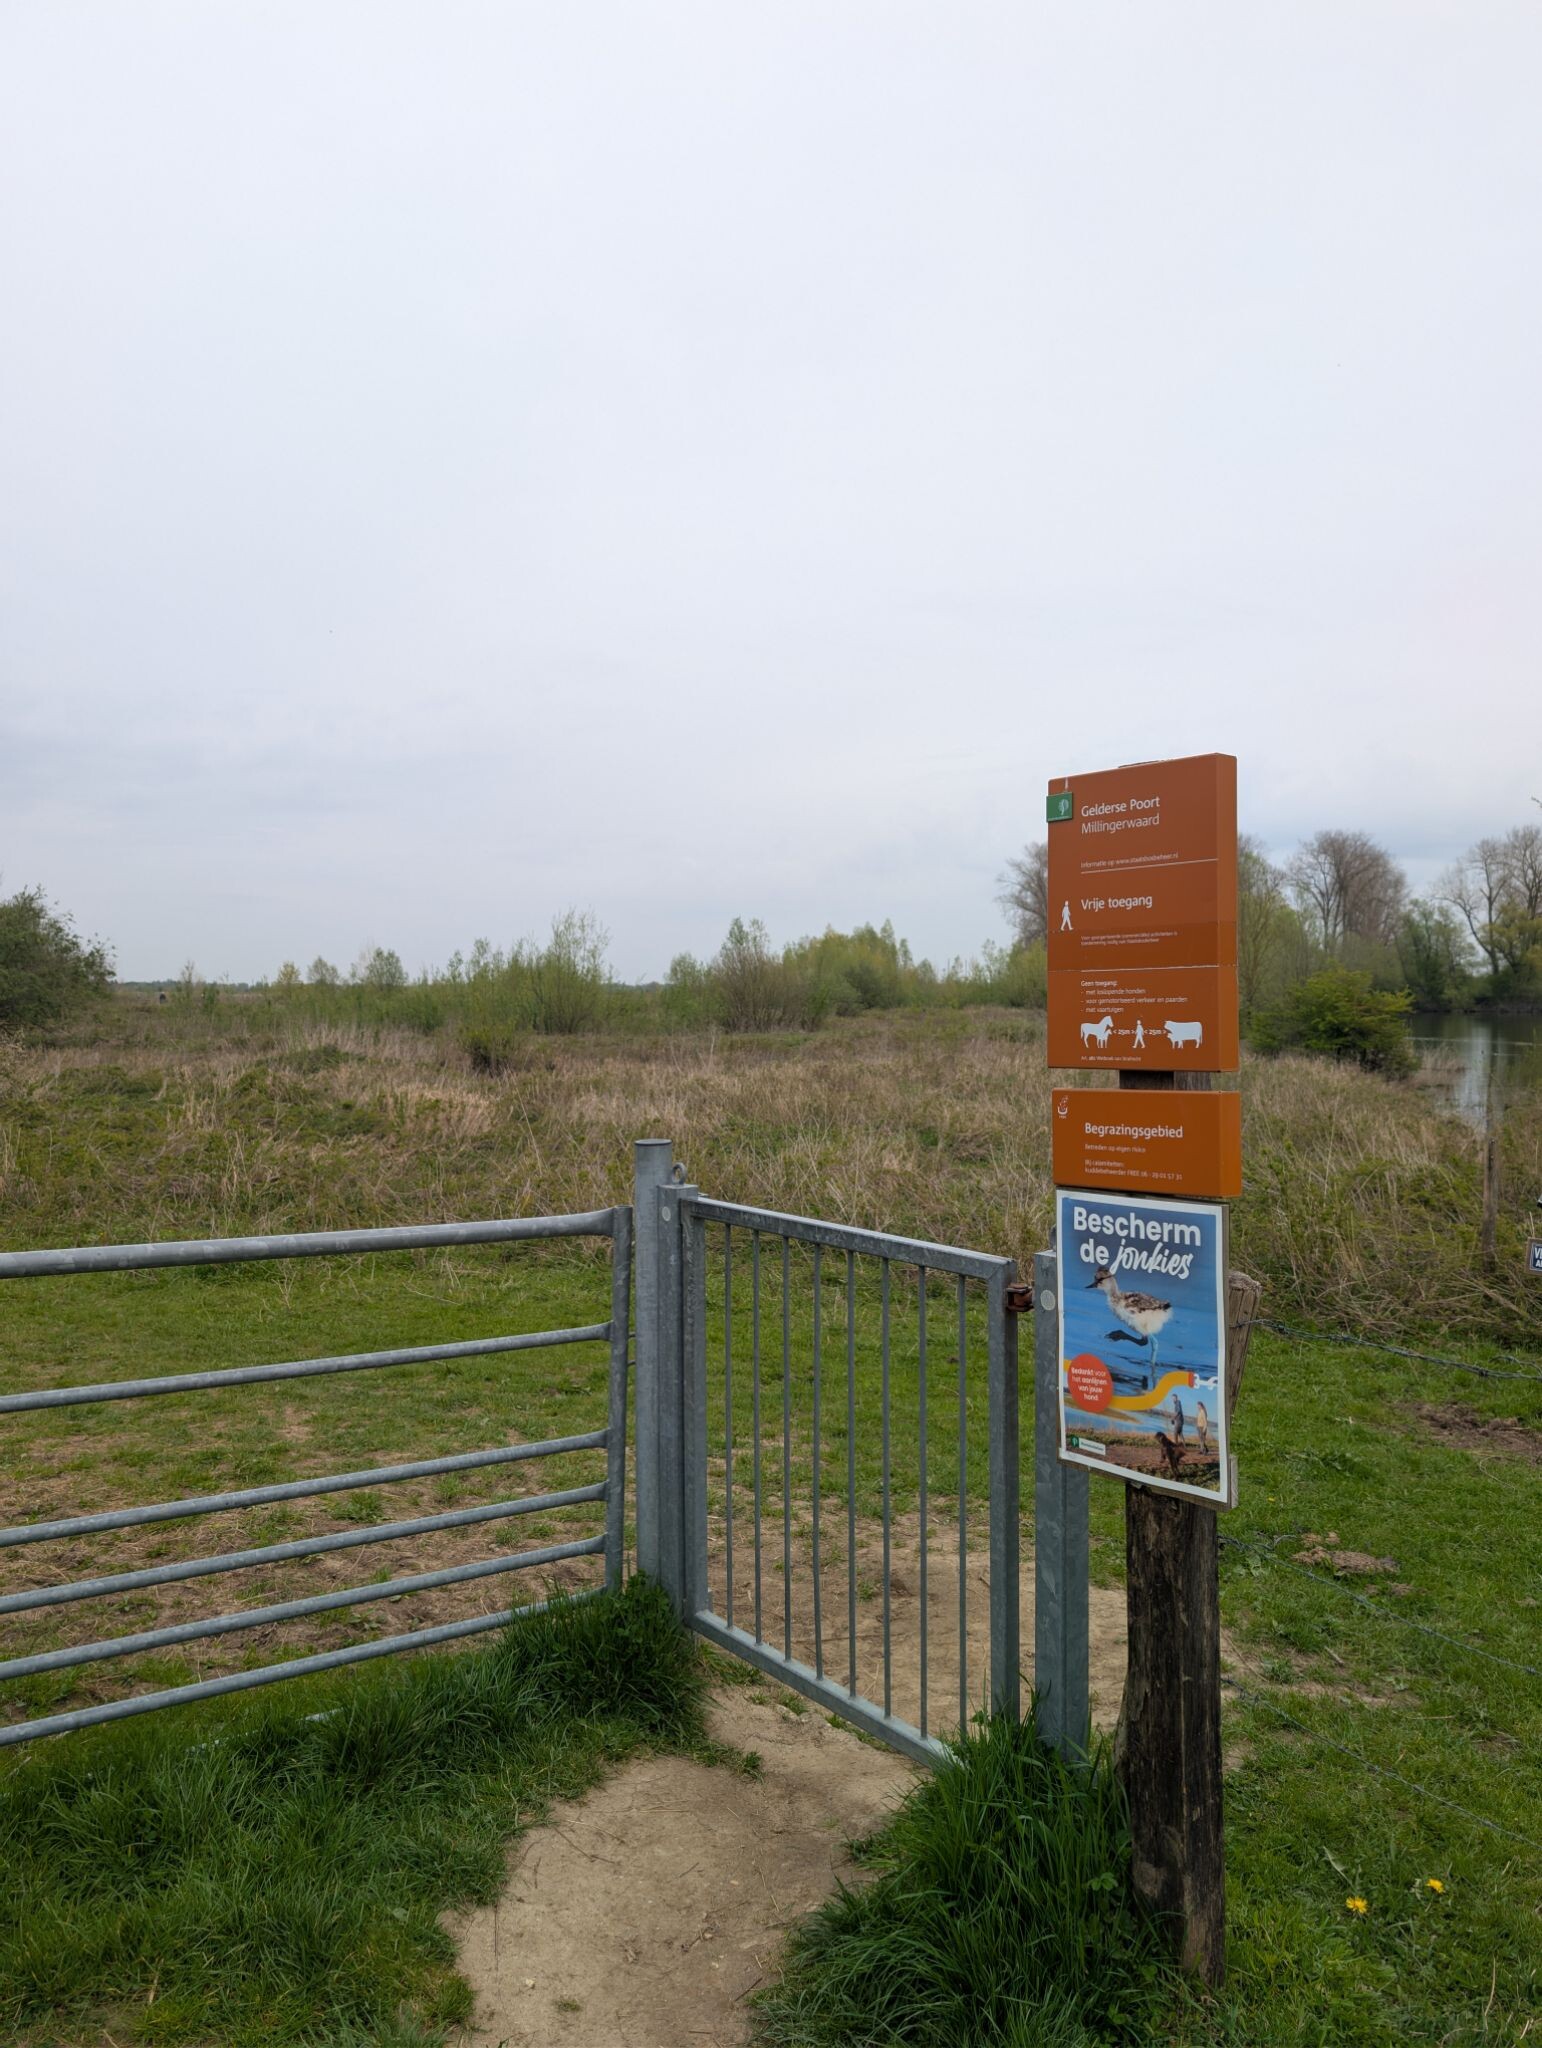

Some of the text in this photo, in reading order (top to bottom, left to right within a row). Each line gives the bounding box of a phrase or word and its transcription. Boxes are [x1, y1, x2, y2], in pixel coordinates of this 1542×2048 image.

[1081, 796, 1160, 817] Gelderse Poort
[1081, 813, 1160, 835] Millingerwaard
[1081, 895, 1153, 912] Vrije toegang
[1084, 1122, 1184, 1140] Begrazingsgebied
[1073, 1206, 1202, 1247] Bescherm
[1080, 1238, 1194, 1280] de jonkies
